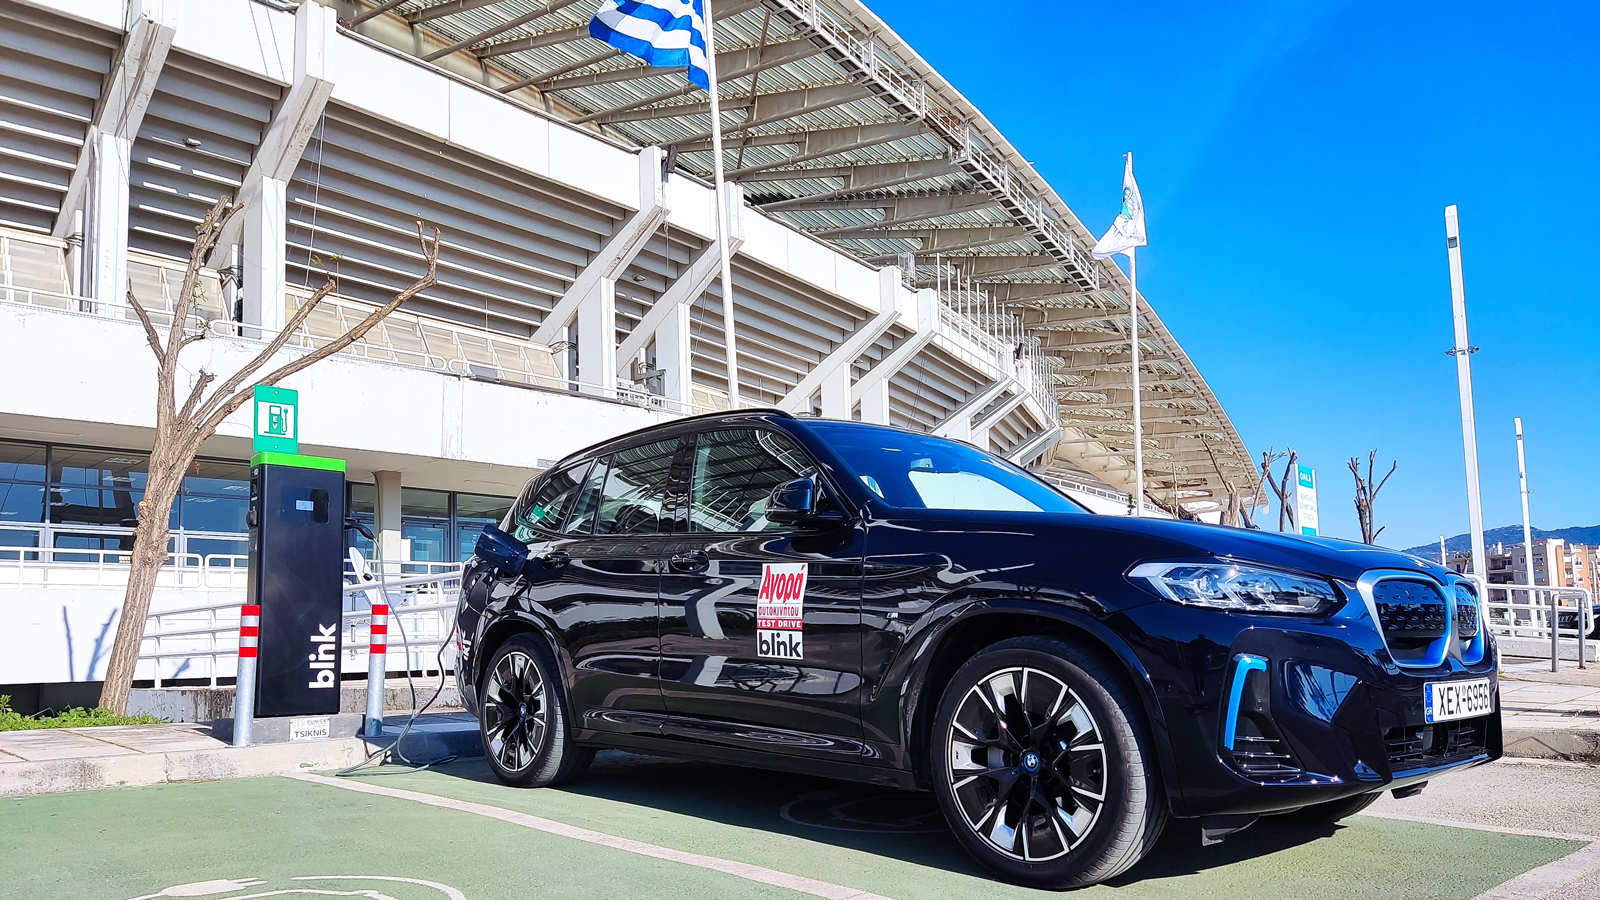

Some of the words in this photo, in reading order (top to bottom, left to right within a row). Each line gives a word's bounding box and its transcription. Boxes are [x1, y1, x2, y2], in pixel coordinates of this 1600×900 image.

[757, 619, 776, 628] TEST
[778, 620, 802, 629] DRIVE
[758, 632, 802, 658] blink
[308, 622, 337, 689] blink
[293, 728, 327, 738] TSIKNIS
